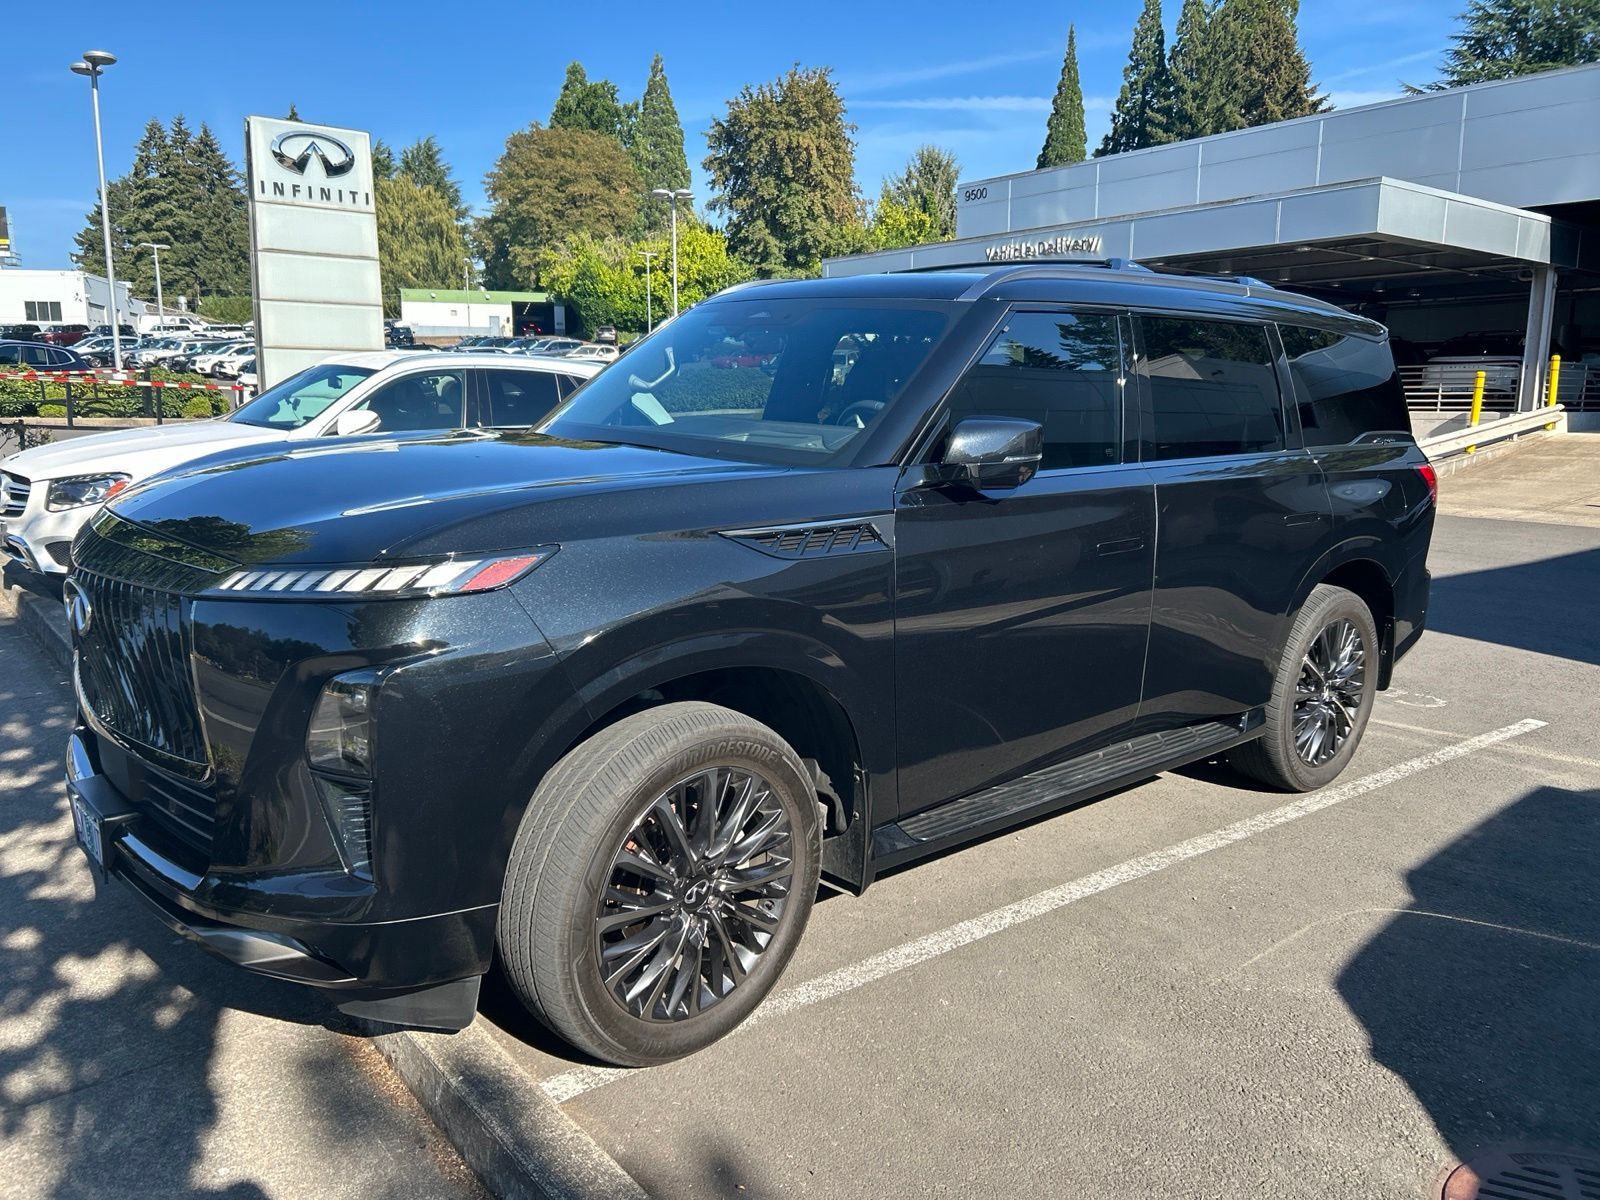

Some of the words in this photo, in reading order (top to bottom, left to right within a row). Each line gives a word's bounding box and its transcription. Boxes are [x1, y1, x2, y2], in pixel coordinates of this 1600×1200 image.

[260, 180, 369, 205] INFINITI
[964, 187, 988, 202] 9500
[985, 241, 1035, 261] Vehicle
[1038, 236, 1101, 256] Delivery
[674, 740, 779, 771] BRIDGESTONE
